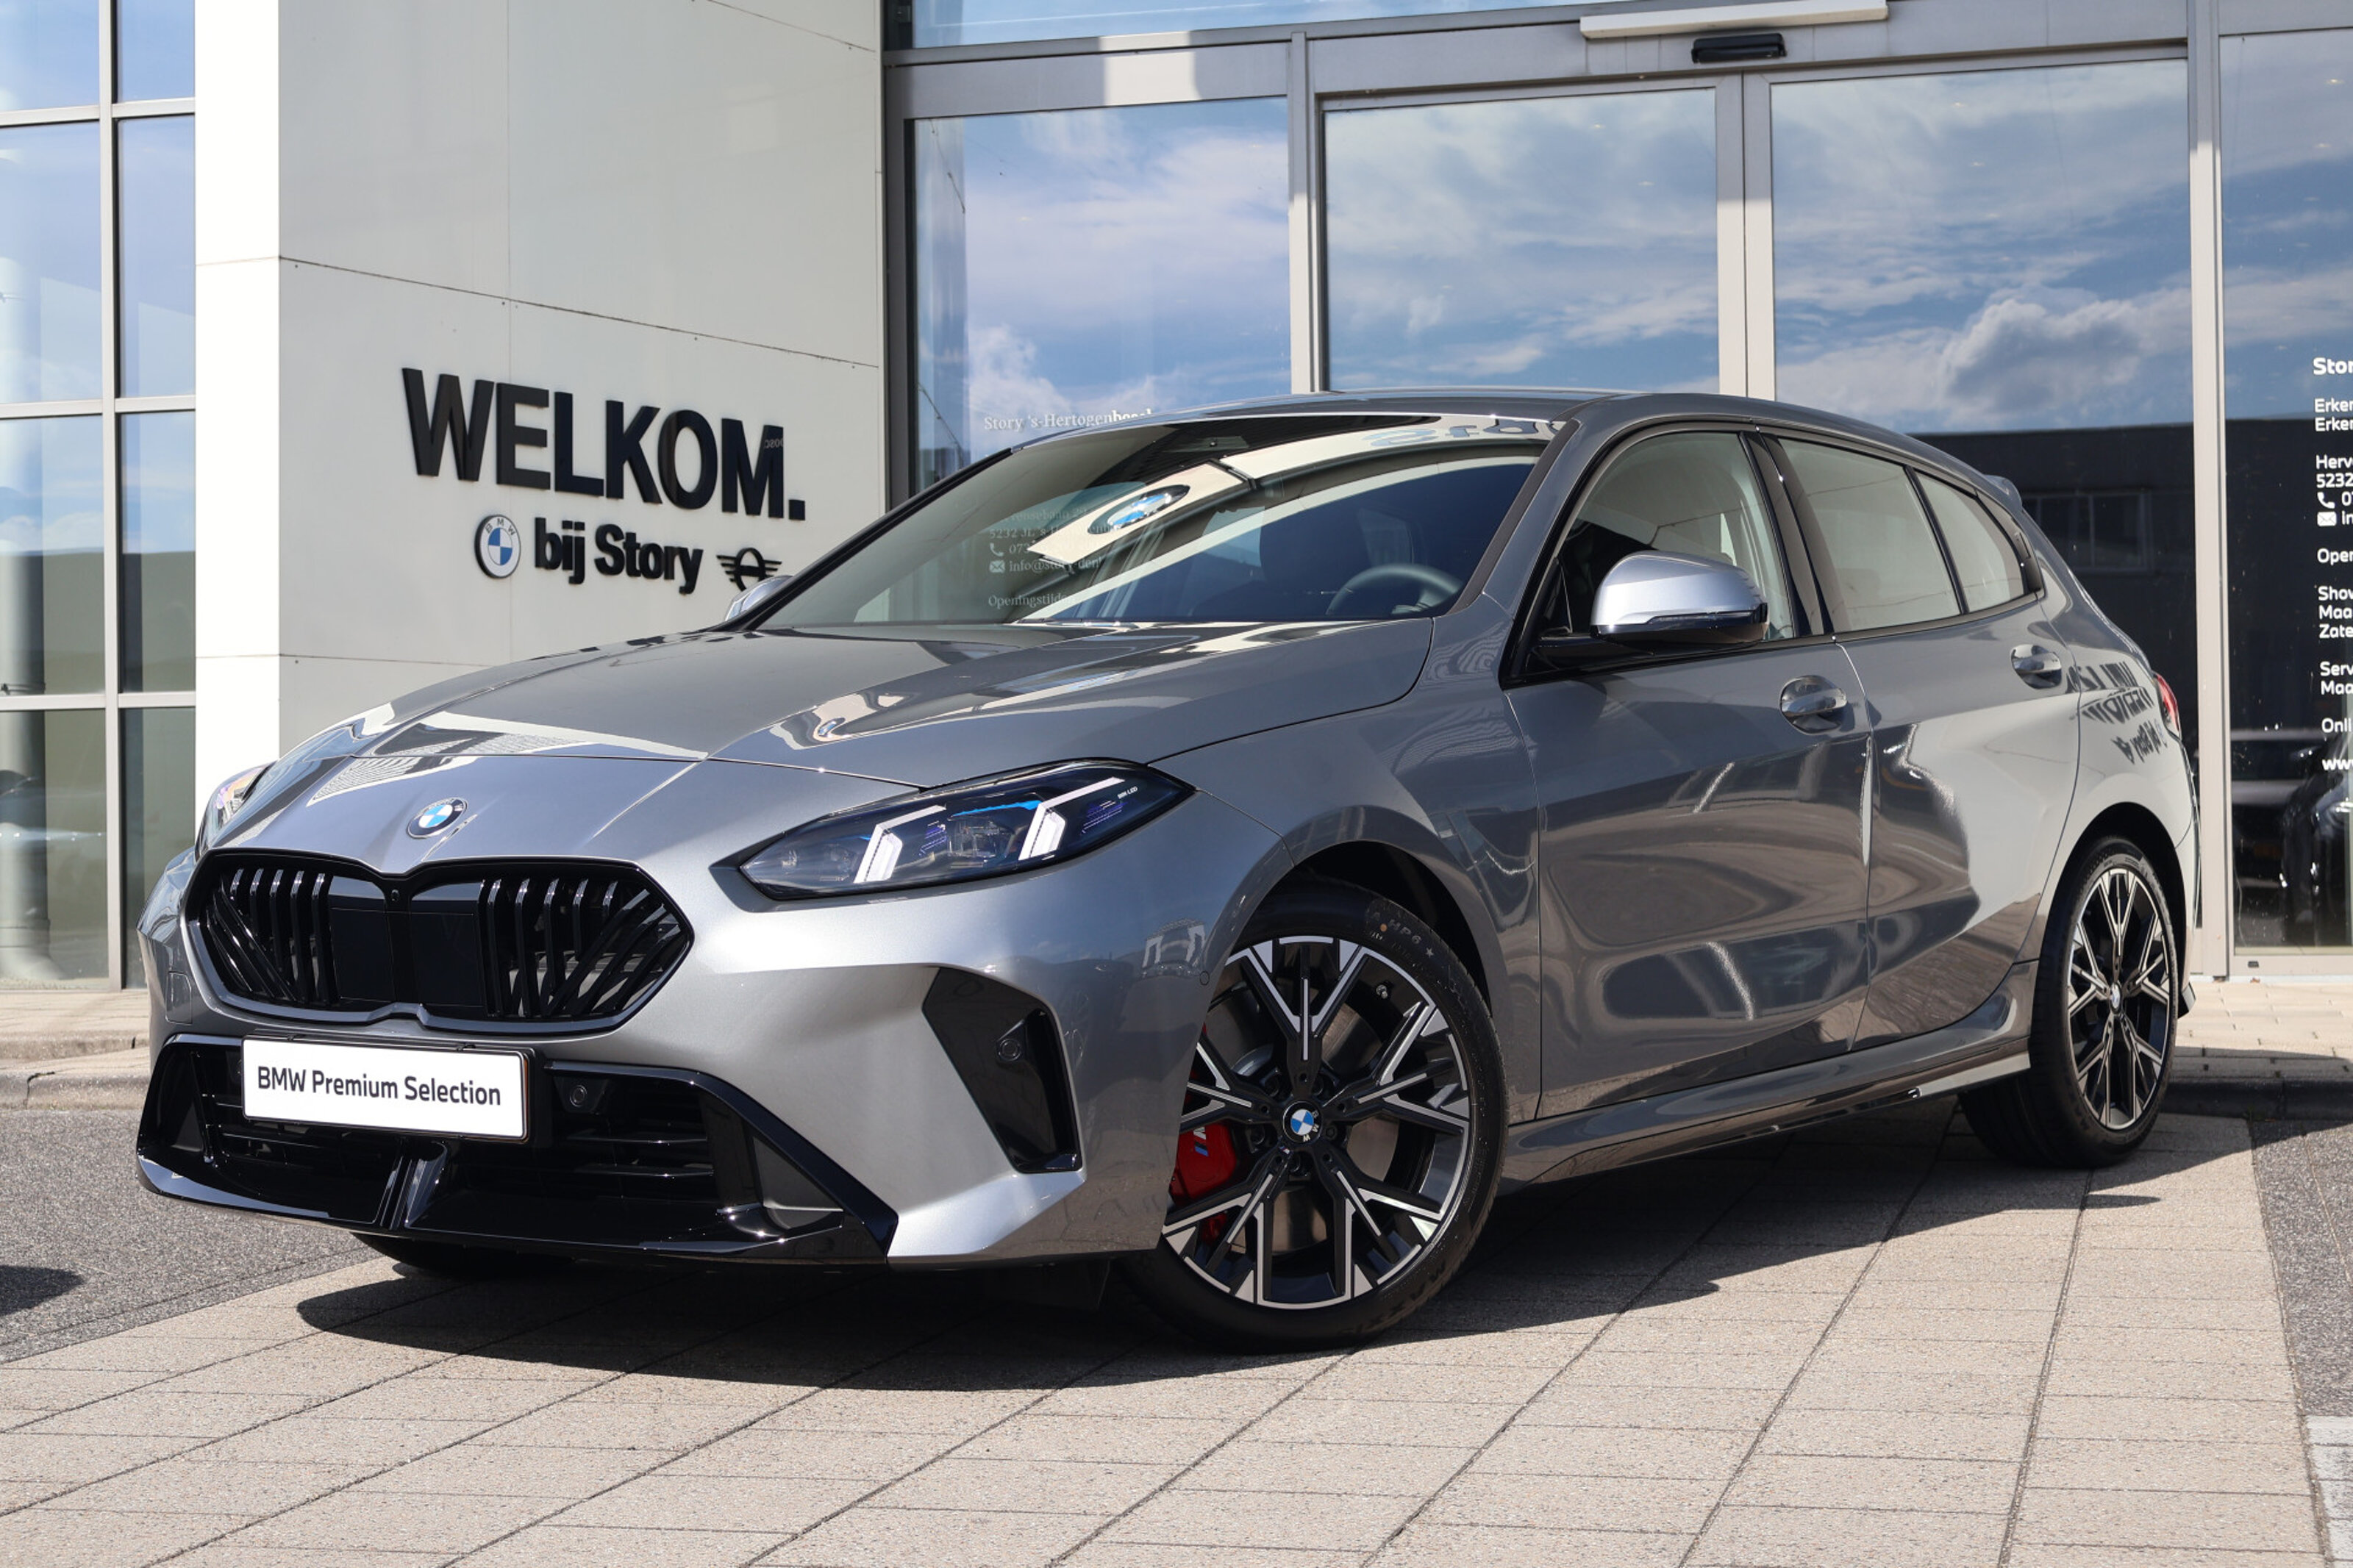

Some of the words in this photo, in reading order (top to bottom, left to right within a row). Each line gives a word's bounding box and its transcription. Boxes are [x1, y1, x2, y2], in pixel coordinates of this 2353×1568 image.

[985, 416, 1024, 432] Story
[1028, 408, 1153, 428] 's-Hertogenb
[402, 368, 805, 521] WELKOM.
[485, 518, 516, 535] BMW
[535, 517, 585, 585] bij
[594, 524, 703, 595] Story
[257, 1066, 307, 1092] BMW
[313, 1070, 398, 1099] Premium
[404, 1075, 501, 1106] Selection
[1302, 1109, 1320, 1142] BMW
